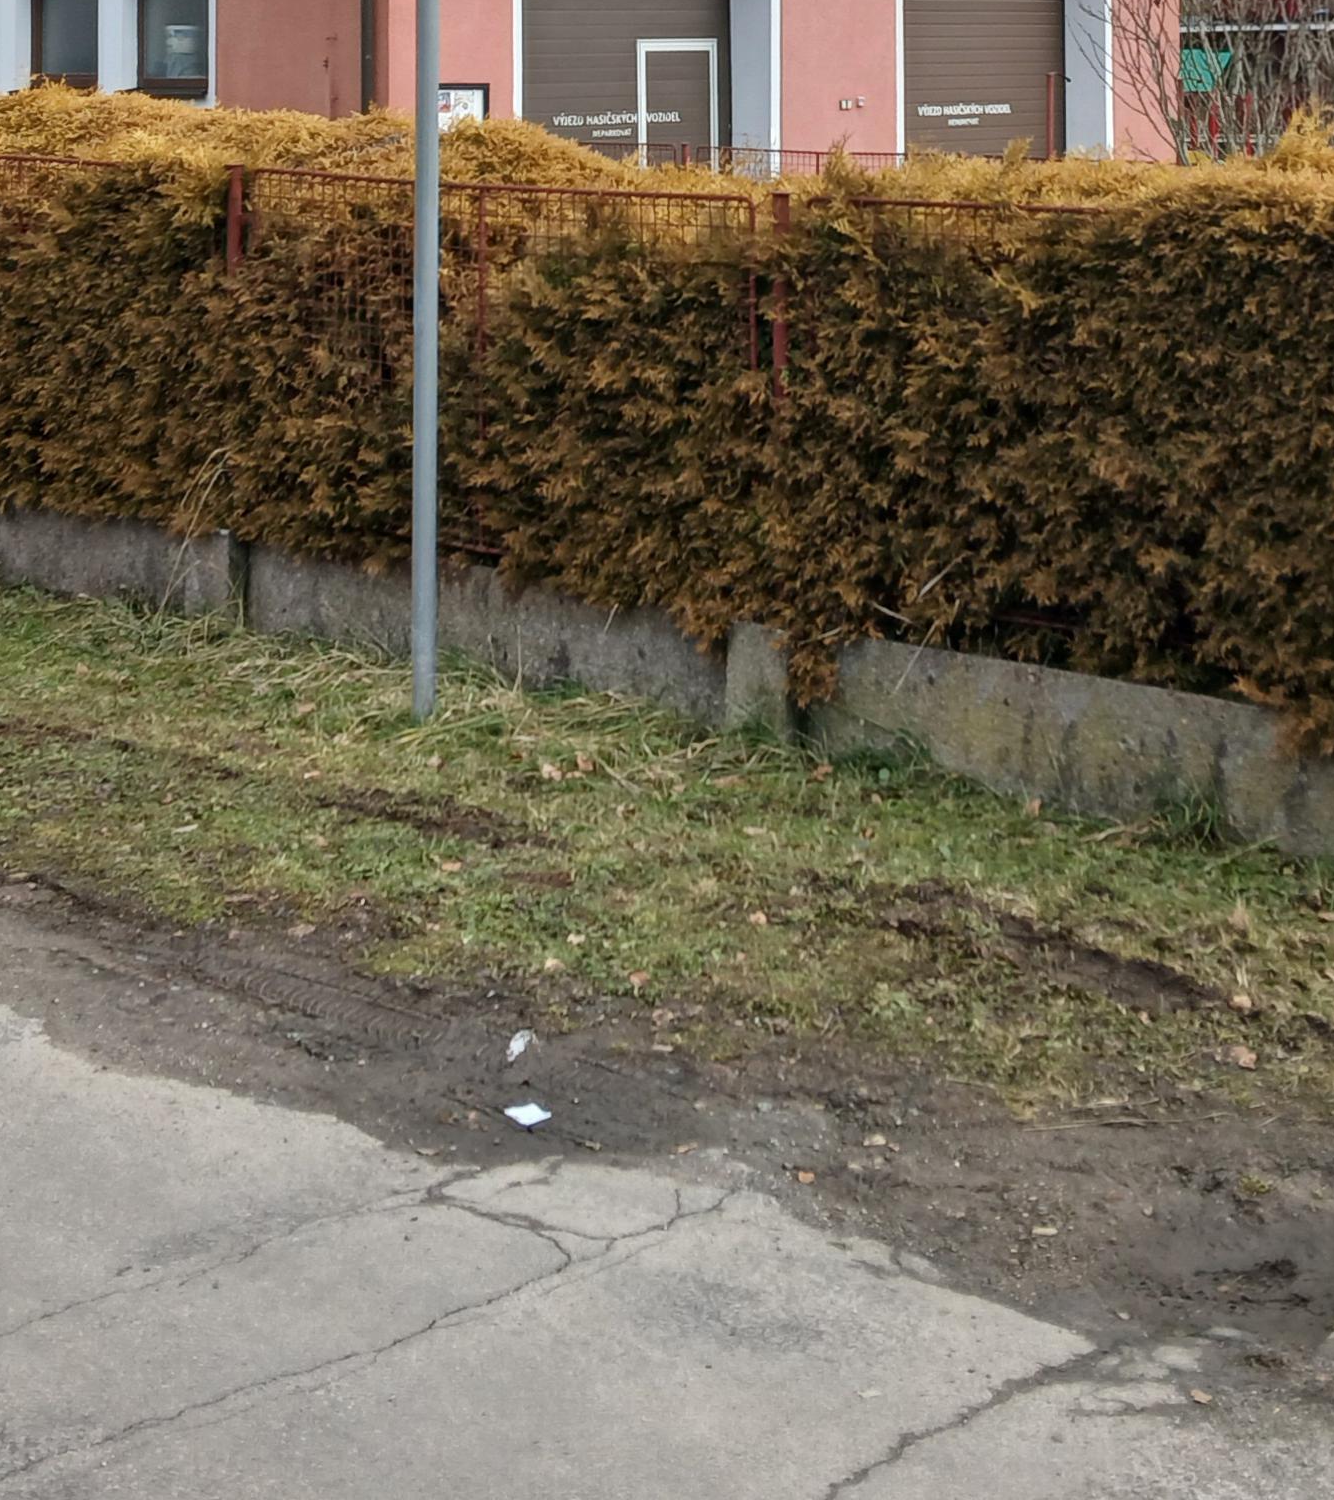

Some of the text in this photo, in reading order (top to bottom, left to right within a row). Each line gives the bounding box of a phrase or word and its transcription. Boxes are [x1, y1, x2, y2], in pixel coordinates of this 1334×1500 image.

[553, 111, 680, 126] VÝJEZD HASIČSKÝCH VOZIDEL
